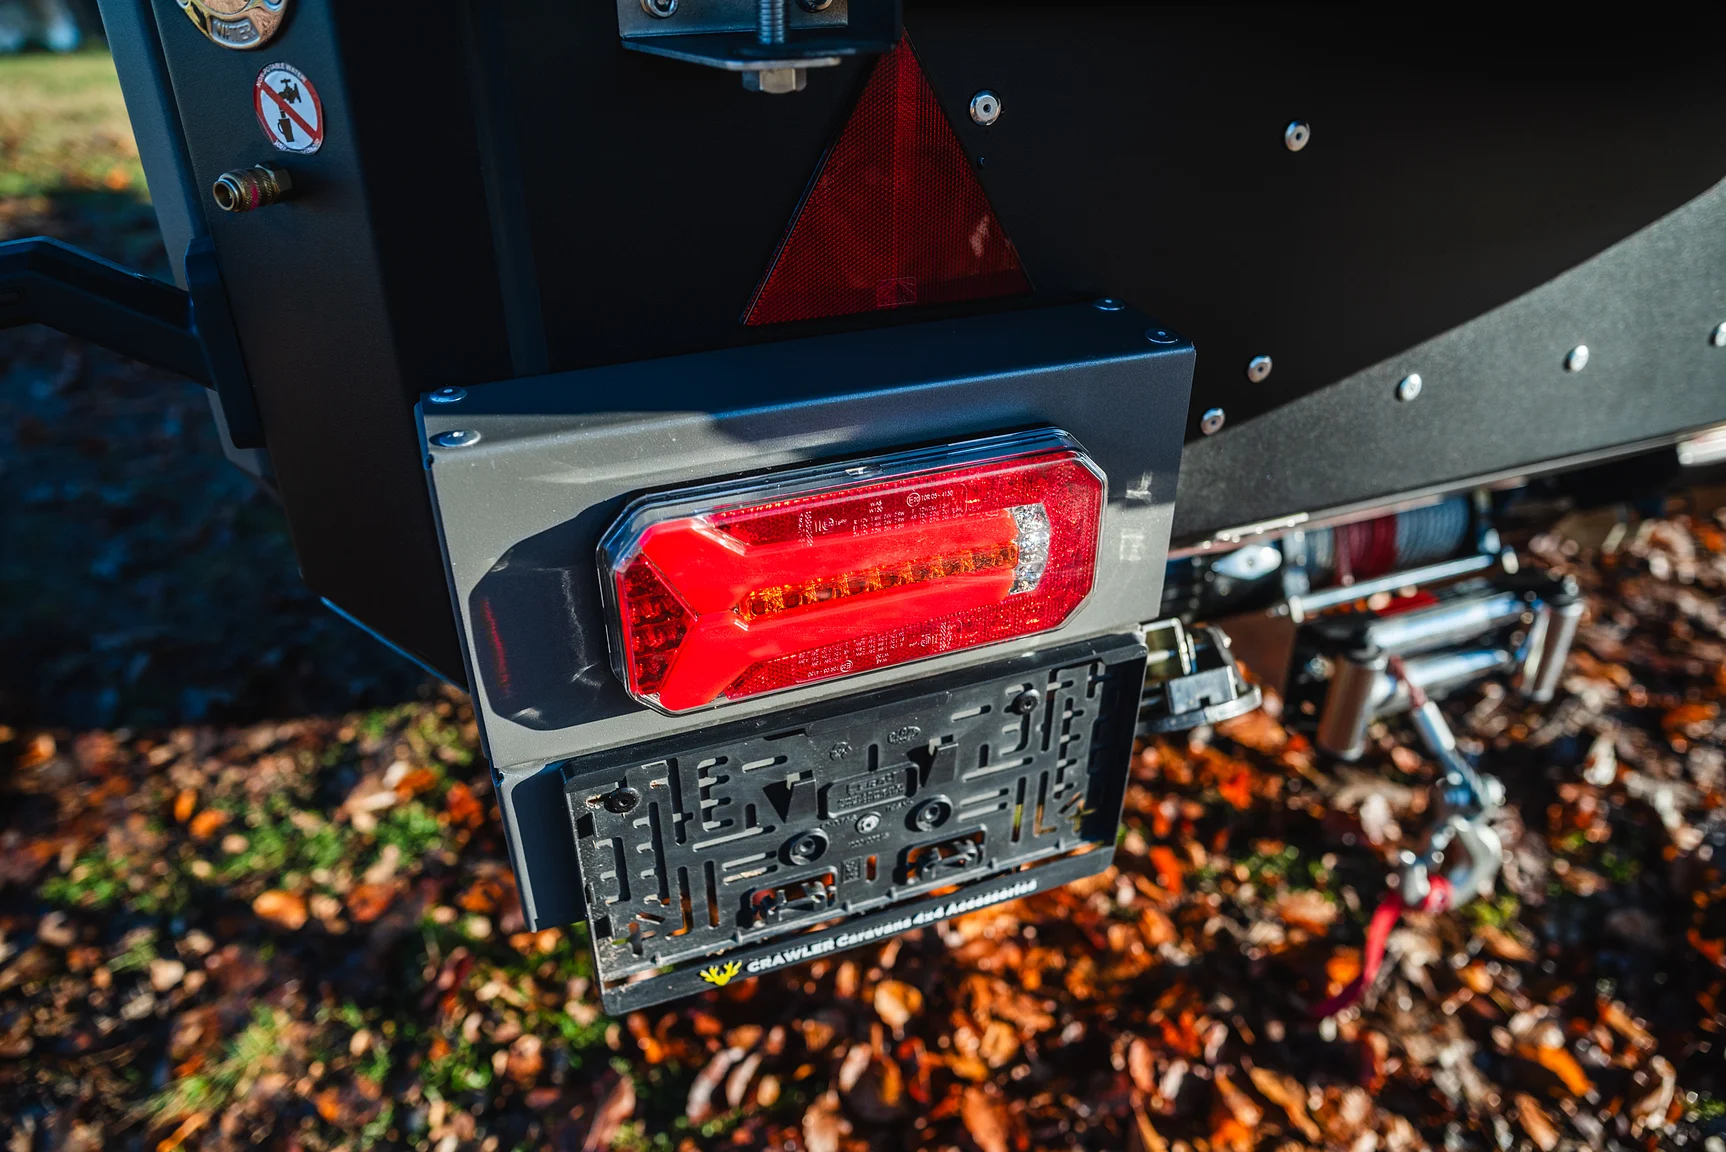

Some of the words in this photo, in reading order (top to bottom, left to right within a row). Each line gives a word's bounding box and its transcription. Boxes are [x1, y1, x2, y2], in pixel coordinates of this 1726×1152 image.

[213, 20, 256, 41] WATER
[746, 938, 835, 973] CRAWLER
[836, 917, 912, 948] Caravans
[912, 905, 944, 925] 4x4
[946, 879, 1038, 916] Accessories
